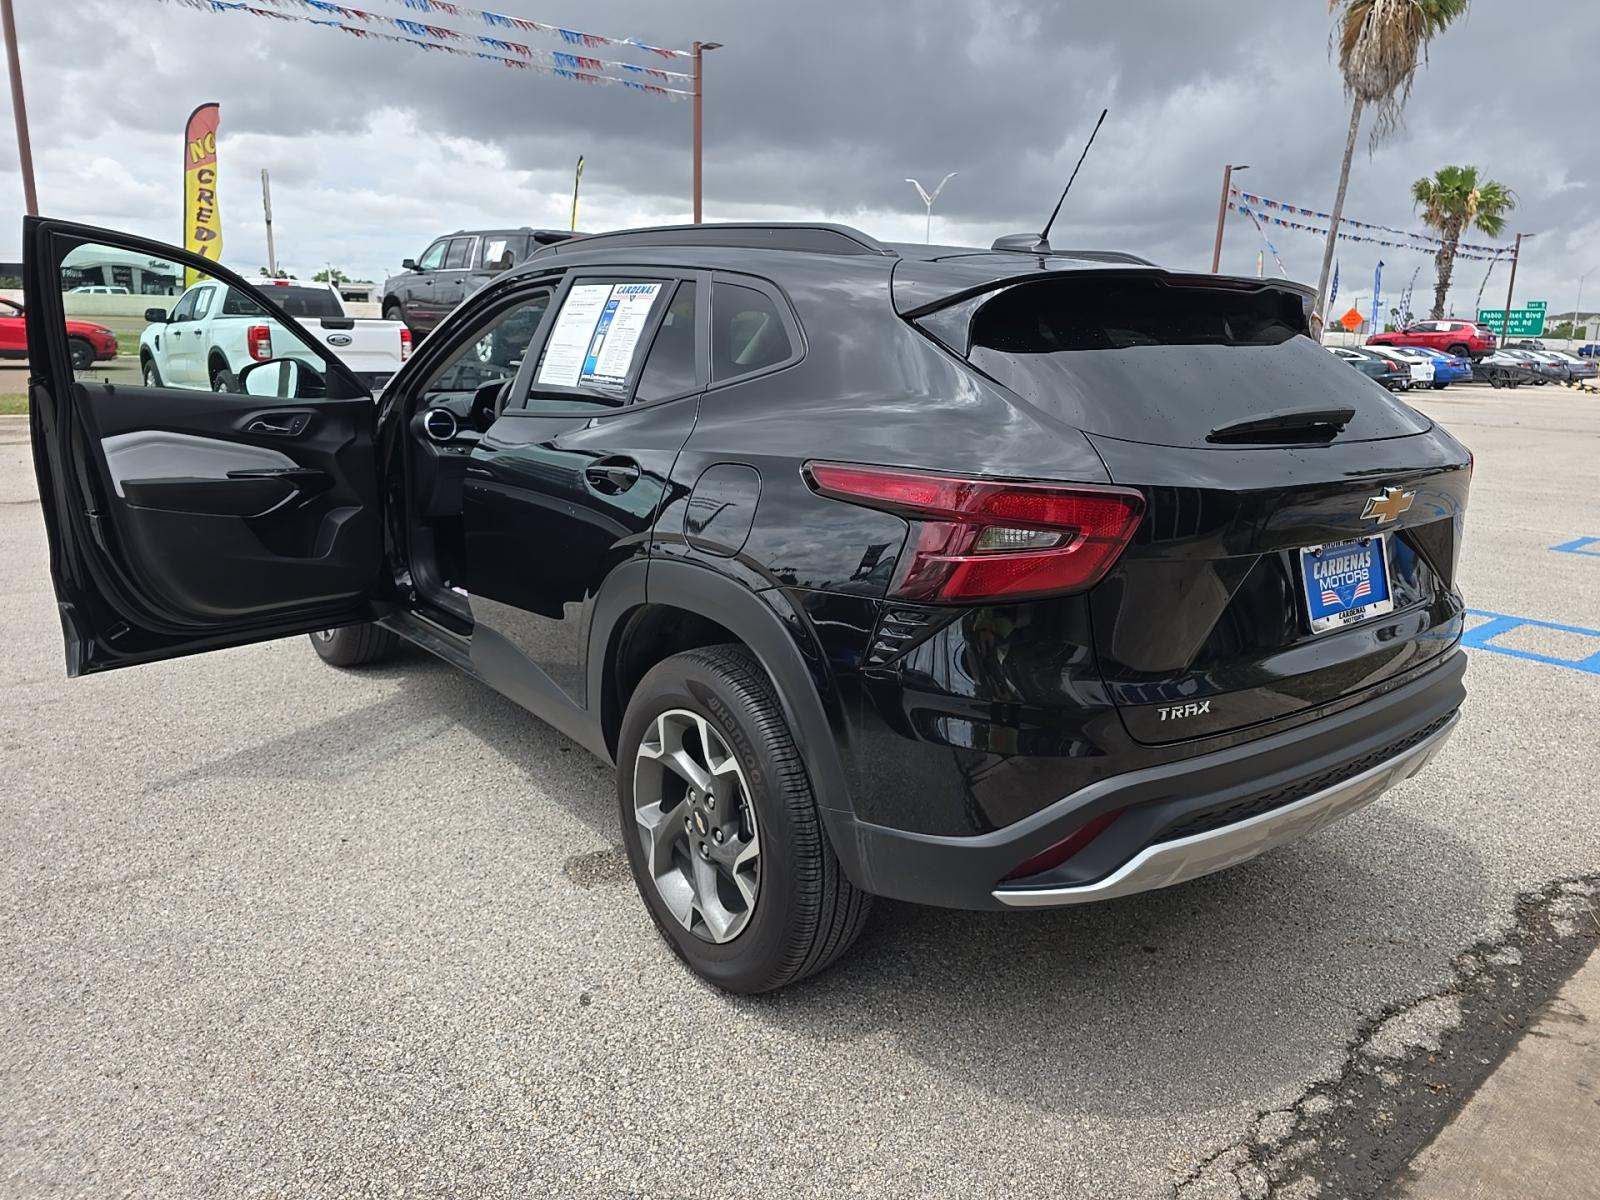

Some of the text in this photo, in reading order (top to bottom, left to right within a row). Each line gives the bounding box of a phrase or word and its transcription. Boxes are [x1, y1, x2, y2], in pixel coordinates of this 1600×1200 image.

[188, 131, 216, 164] NO
[194, 168, 217, 278] CREDI
[616, 285, 657, 295] CARDENAS
[1482, 311, 1541, 319] Pablo isel Blvd
[1313, 551, 1371, 580] CARDENAS
[1320, 568, 1370, 591] MOTORS
[1338, 605, 1367, 619] CARDENAS
[1157, 700, 1211, 721] TRAX
